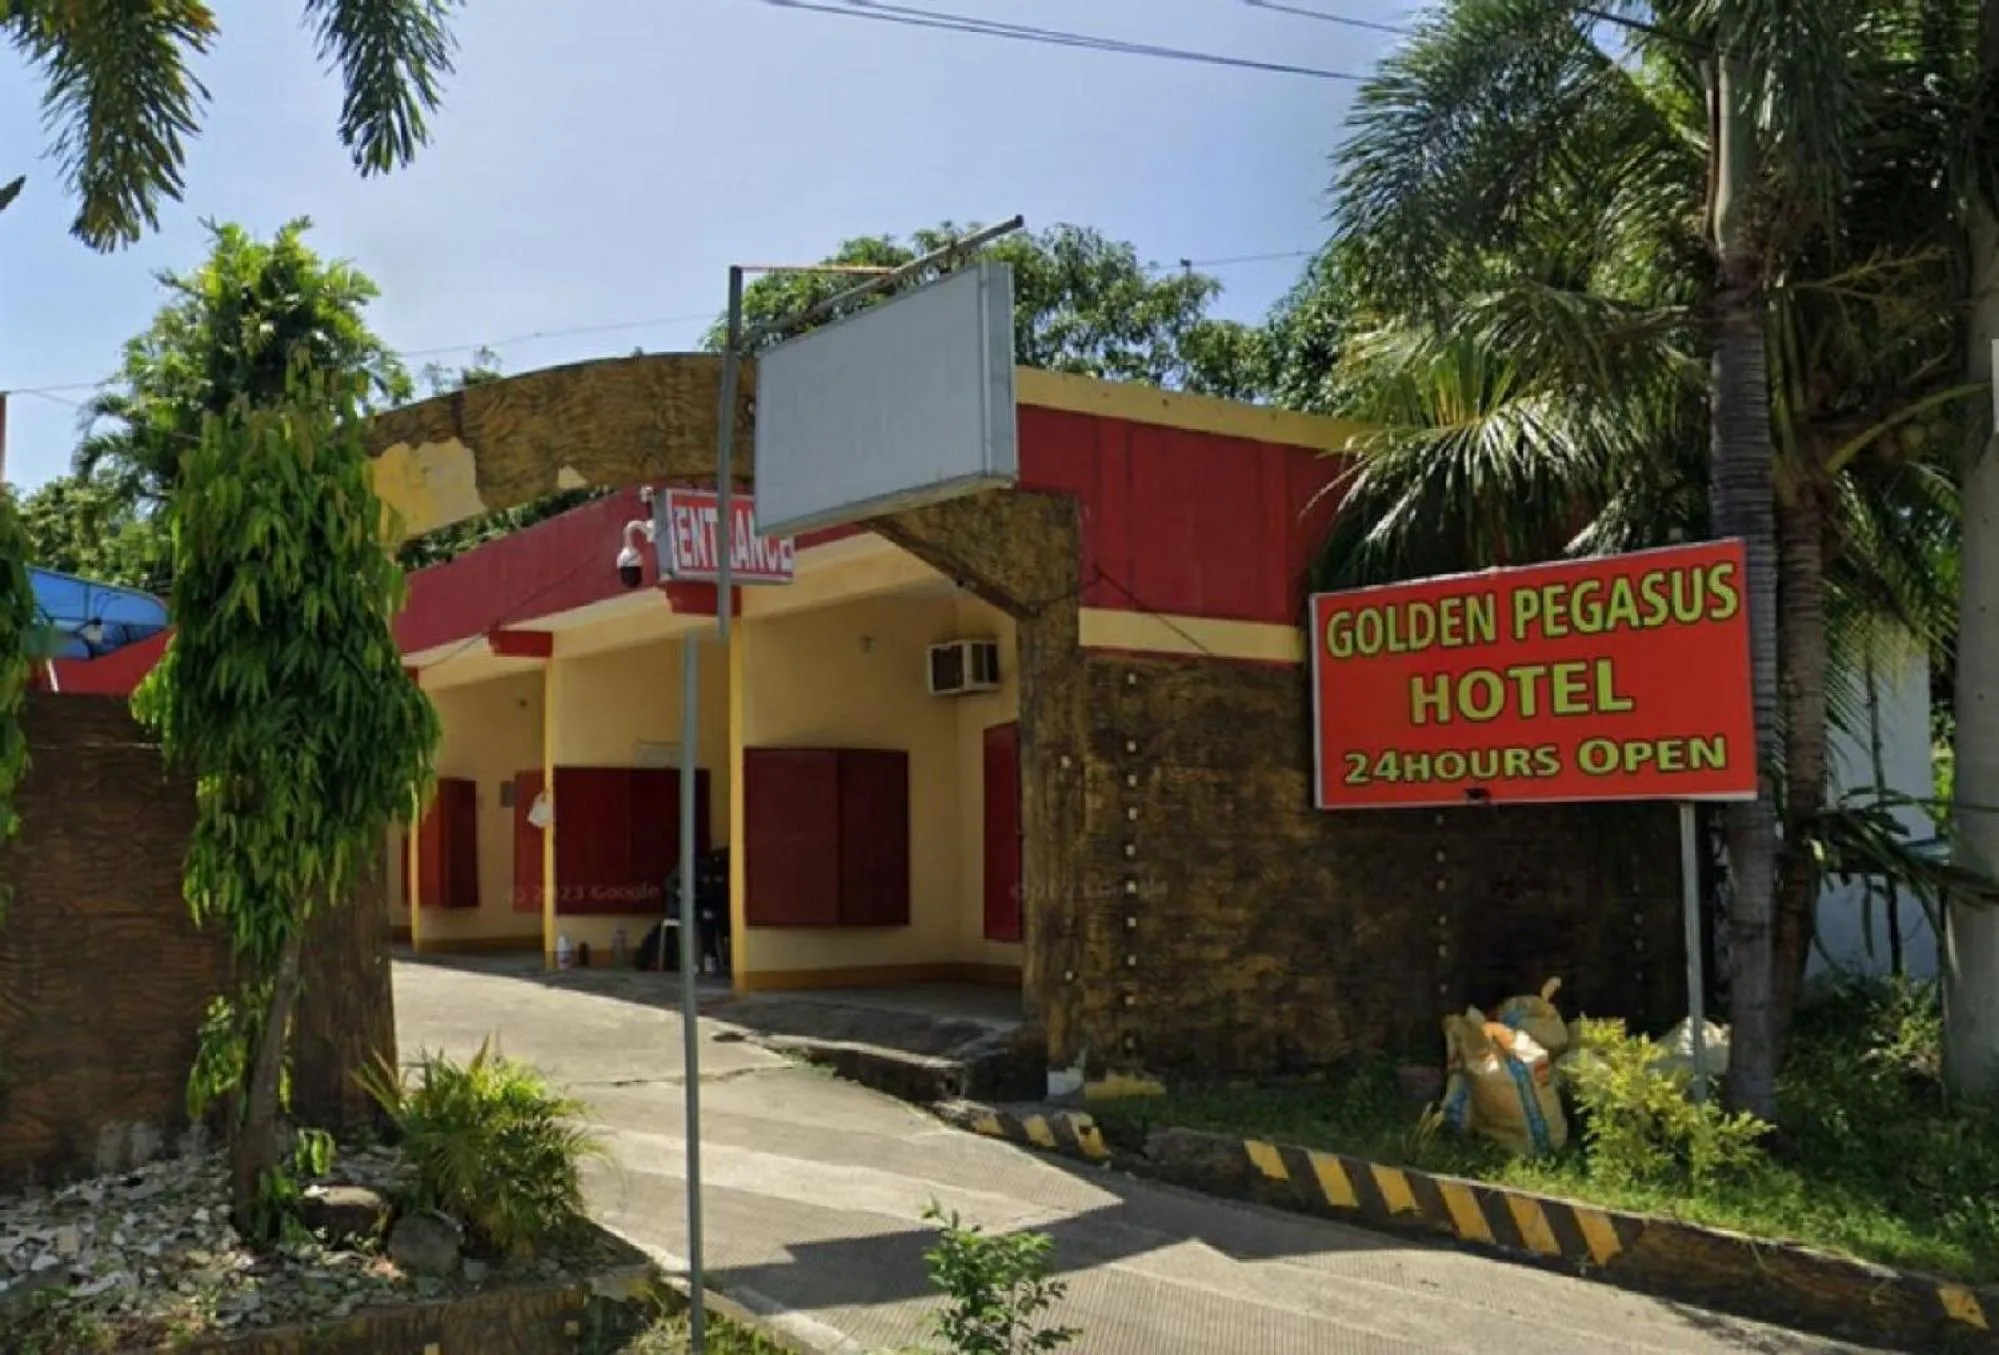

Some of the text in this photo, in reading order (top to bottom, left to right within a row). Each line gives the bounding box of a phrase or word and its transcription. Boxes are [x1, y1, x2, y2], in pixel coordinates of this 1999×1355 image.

[676, 506, 792, 571] ENTANCE
[1326, 561, 1739, 658] GOLDEN PEGASUS
[1408, 656, 1635, 725] HOTEL
[1344, 735, 1728, 784] 24HOURS OPEN
